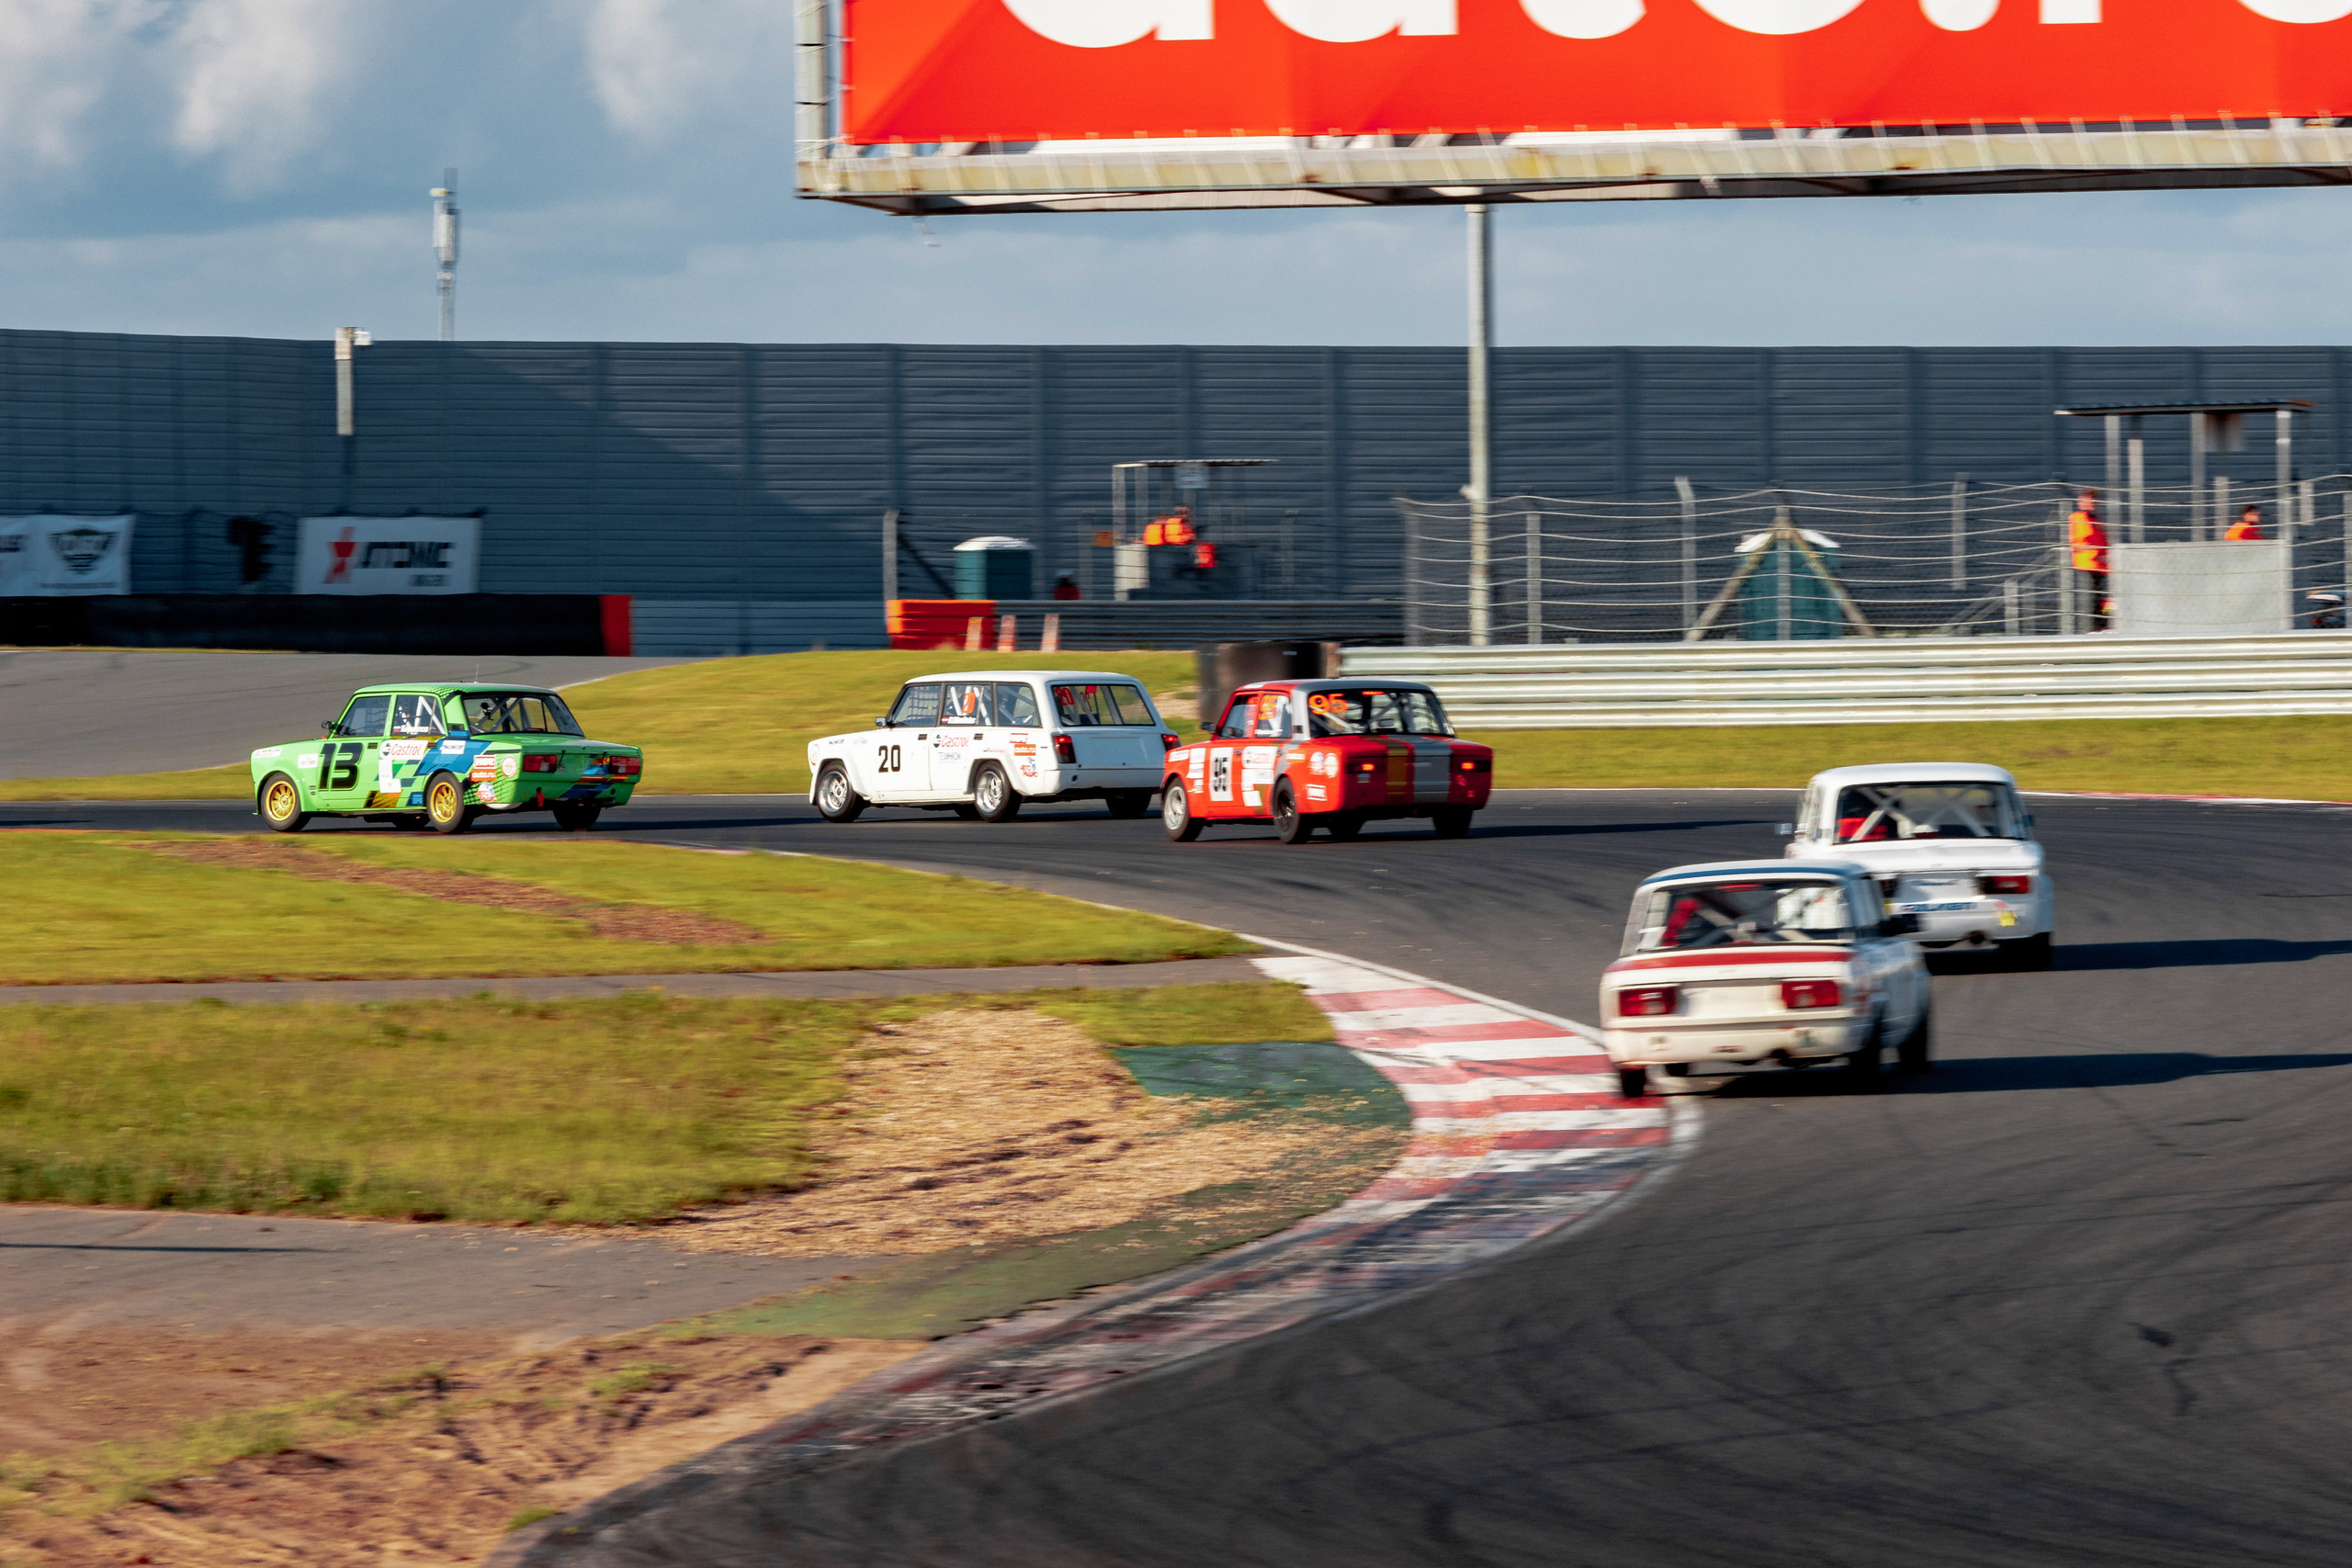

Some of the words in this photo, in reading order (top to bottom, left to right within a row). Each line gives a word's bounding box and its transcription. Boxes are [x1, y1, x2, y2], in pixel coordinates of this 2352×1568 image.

[1055, 686, 1075, 706] 20
[1307, 693, 1350, 716] 95
[390, 743, 422, 756] Castrol
[941, 735, 970, 748] Castrol
[319, 742, 363, 790] 13
[878, 745, 900, 773] 20
